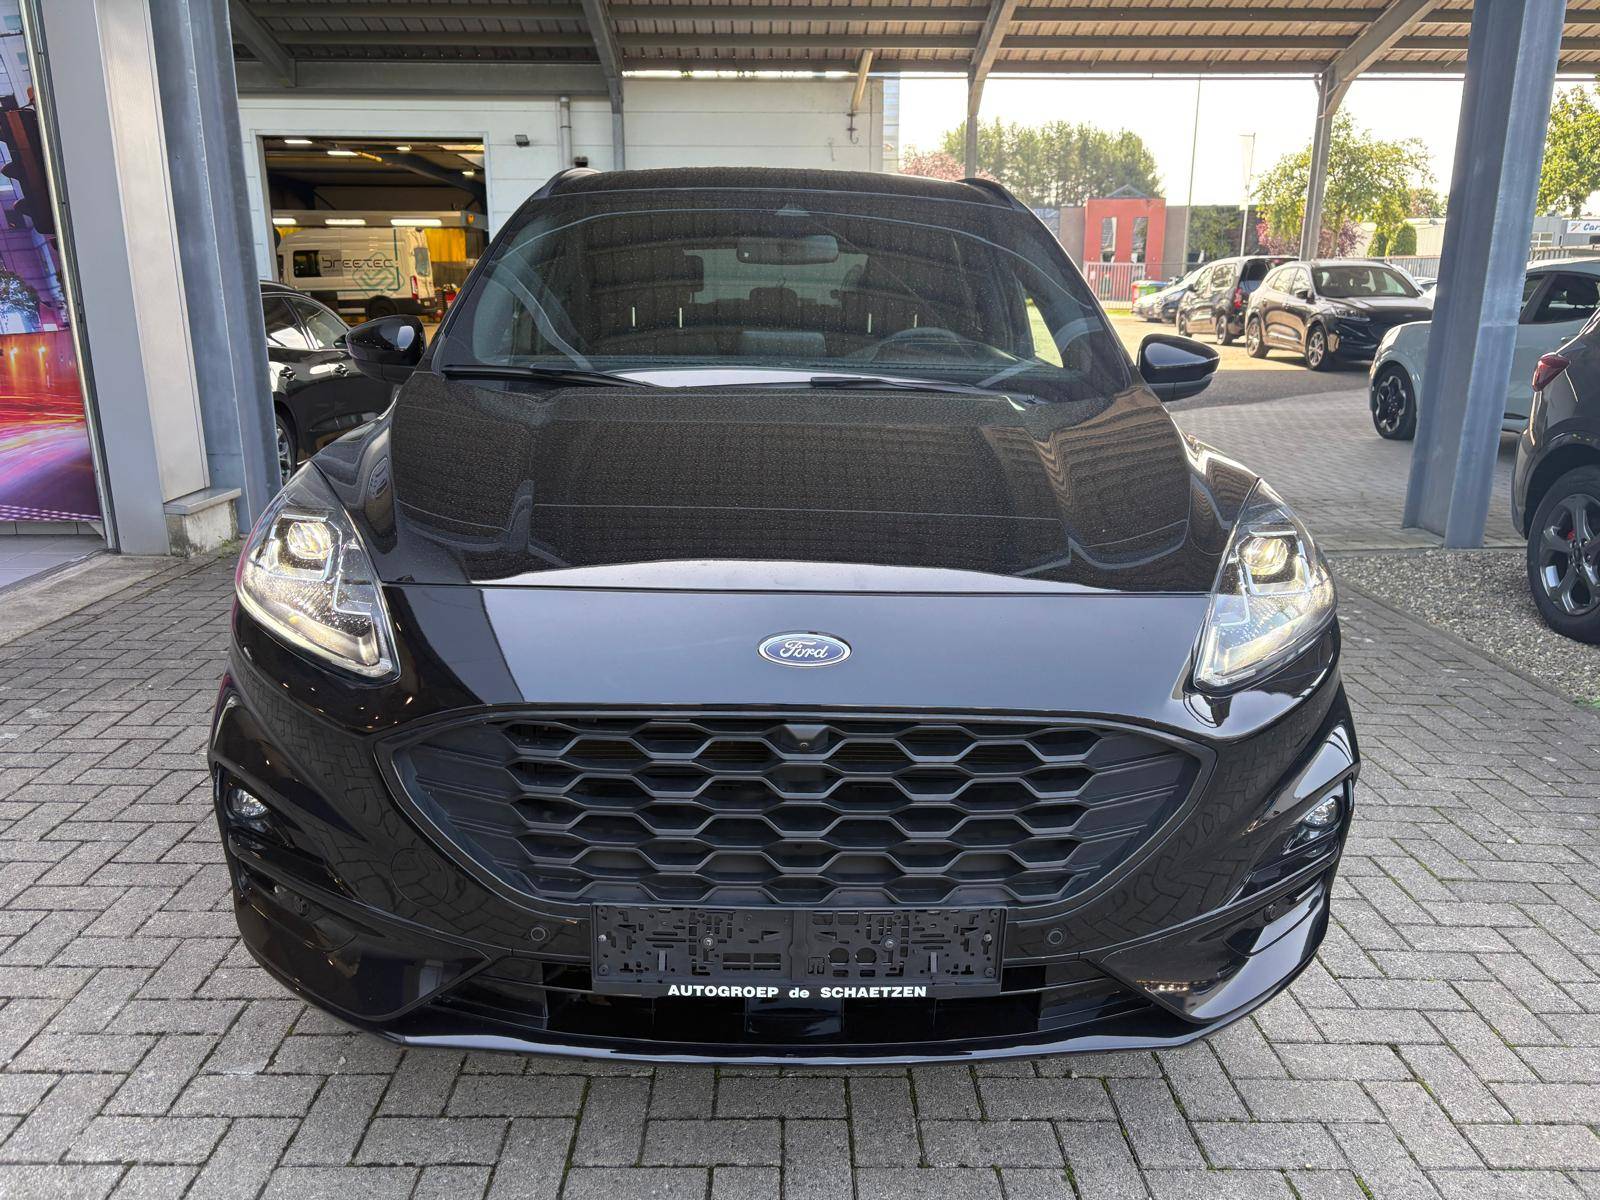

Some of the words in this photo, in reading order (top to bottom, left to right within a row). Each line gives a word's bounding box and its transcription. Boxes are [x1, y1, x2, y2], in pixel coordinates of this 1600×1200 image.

[780, 640, 828, 658] Ford
[667, 984, 779, 998] AUTOGROEP
[788, 987, 810, 998] de
[820, 986, 927, 998] SCHAETZEN
